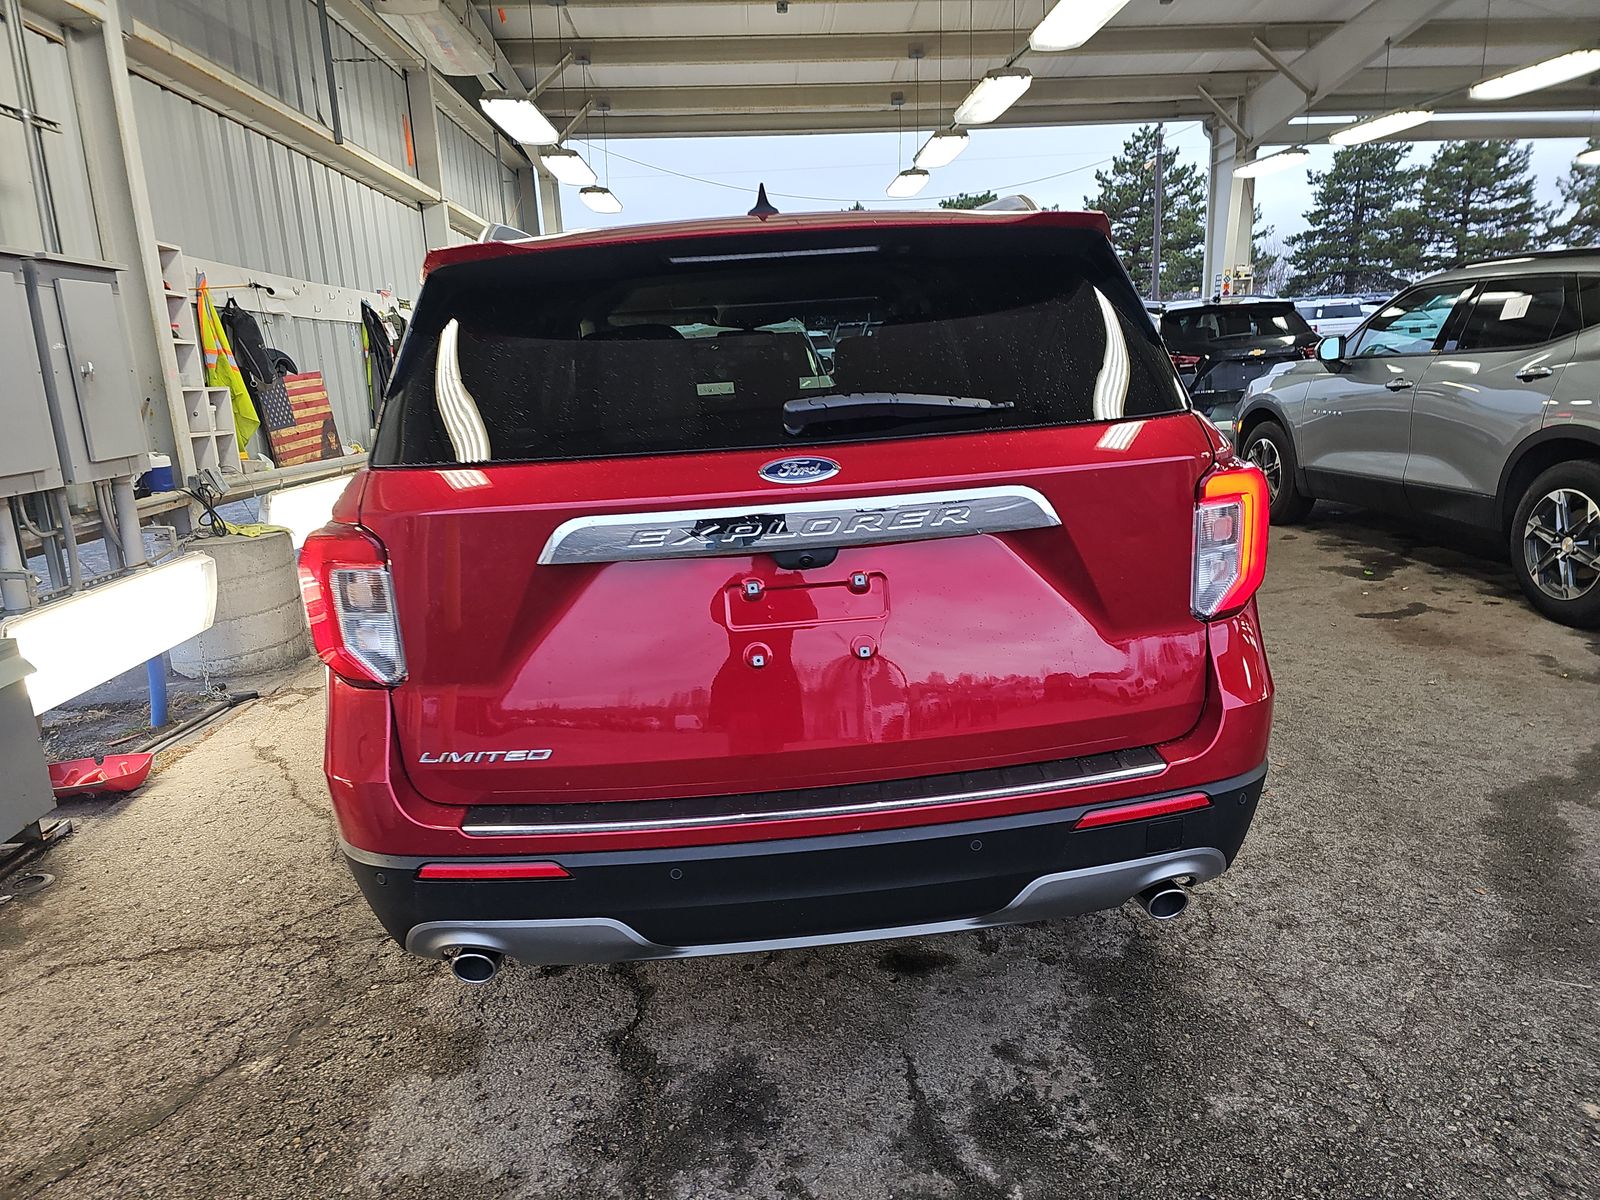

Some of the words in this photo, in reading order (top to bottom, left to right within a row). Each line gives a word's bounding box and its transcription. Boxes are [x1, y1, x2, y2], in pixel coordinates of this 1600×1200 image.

[777, 460, 821, 477] Ford
[626, 505, 972, 548] EXPLORER
[418, 749, 553, 764] LIMITED
